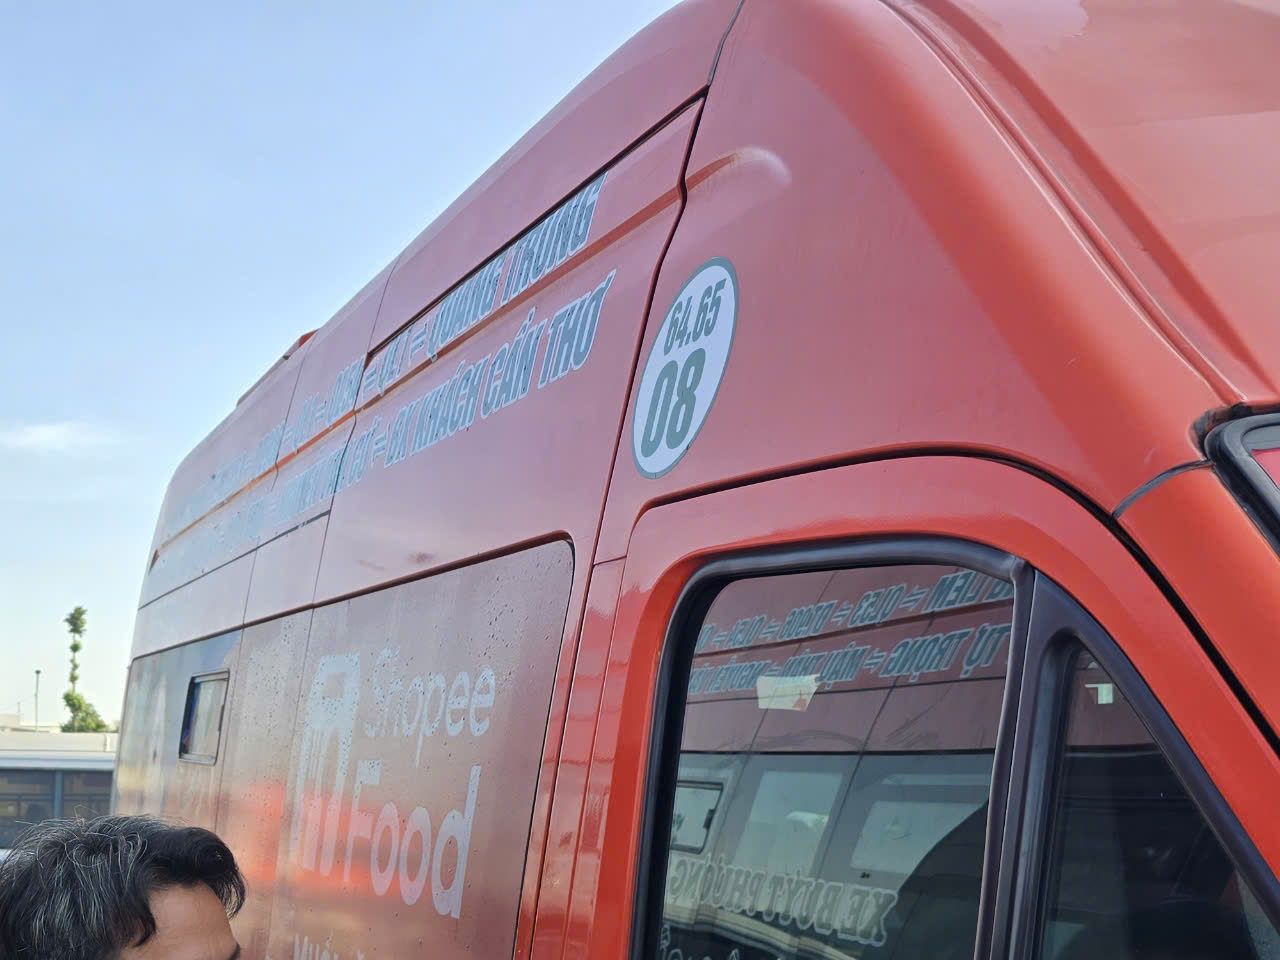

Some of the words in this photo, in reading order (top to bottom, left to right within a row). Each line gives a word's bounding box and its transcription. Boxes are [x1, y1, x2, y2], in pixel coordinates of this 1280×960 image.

[502, 171, 608, 305] TRUNG
[480, 307, 547, 419] CẦN
[538, 269, 616, 389] THƠ
[663, 278, 726, 353] 64.65
[642, 348, 705, 458] 08
[365, 646, 495, 769] Shopee
[344, 760, 481, 919] Food
